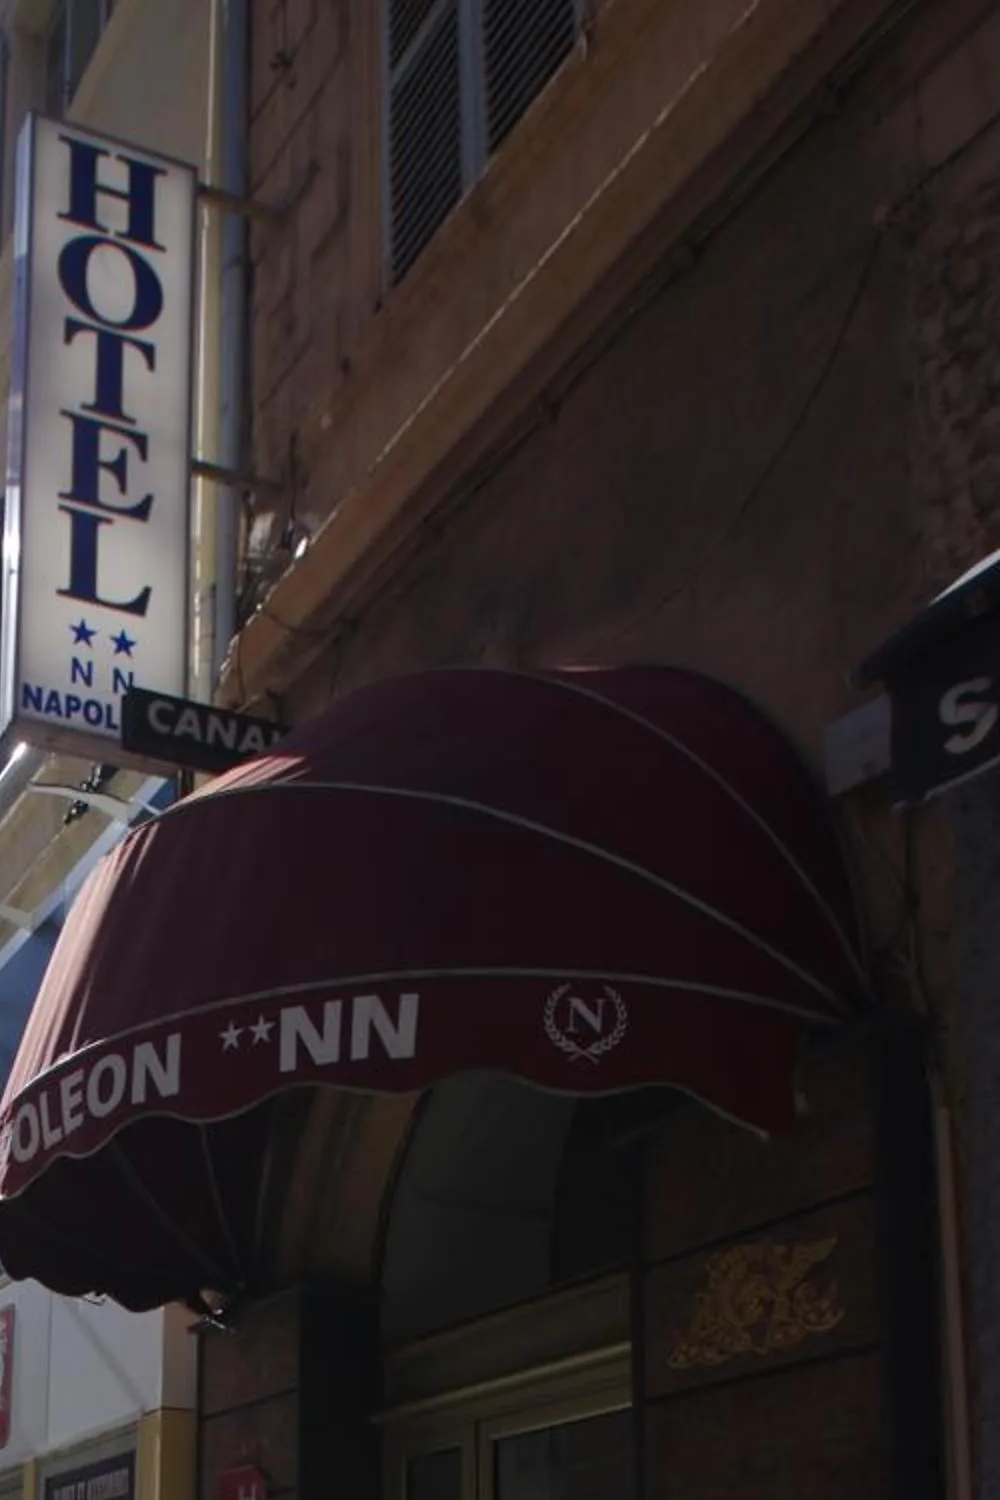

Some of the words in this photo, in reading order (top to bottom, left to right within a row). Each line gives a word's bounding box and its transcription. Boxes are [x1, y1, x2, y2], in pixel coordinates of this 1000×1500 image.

[56, 133, 168, 617] HOTEL
[21, 683, 119, 730] NAPOL
[279, 992, 420, 1073] NN
[564, 996, 606, 1034] N
